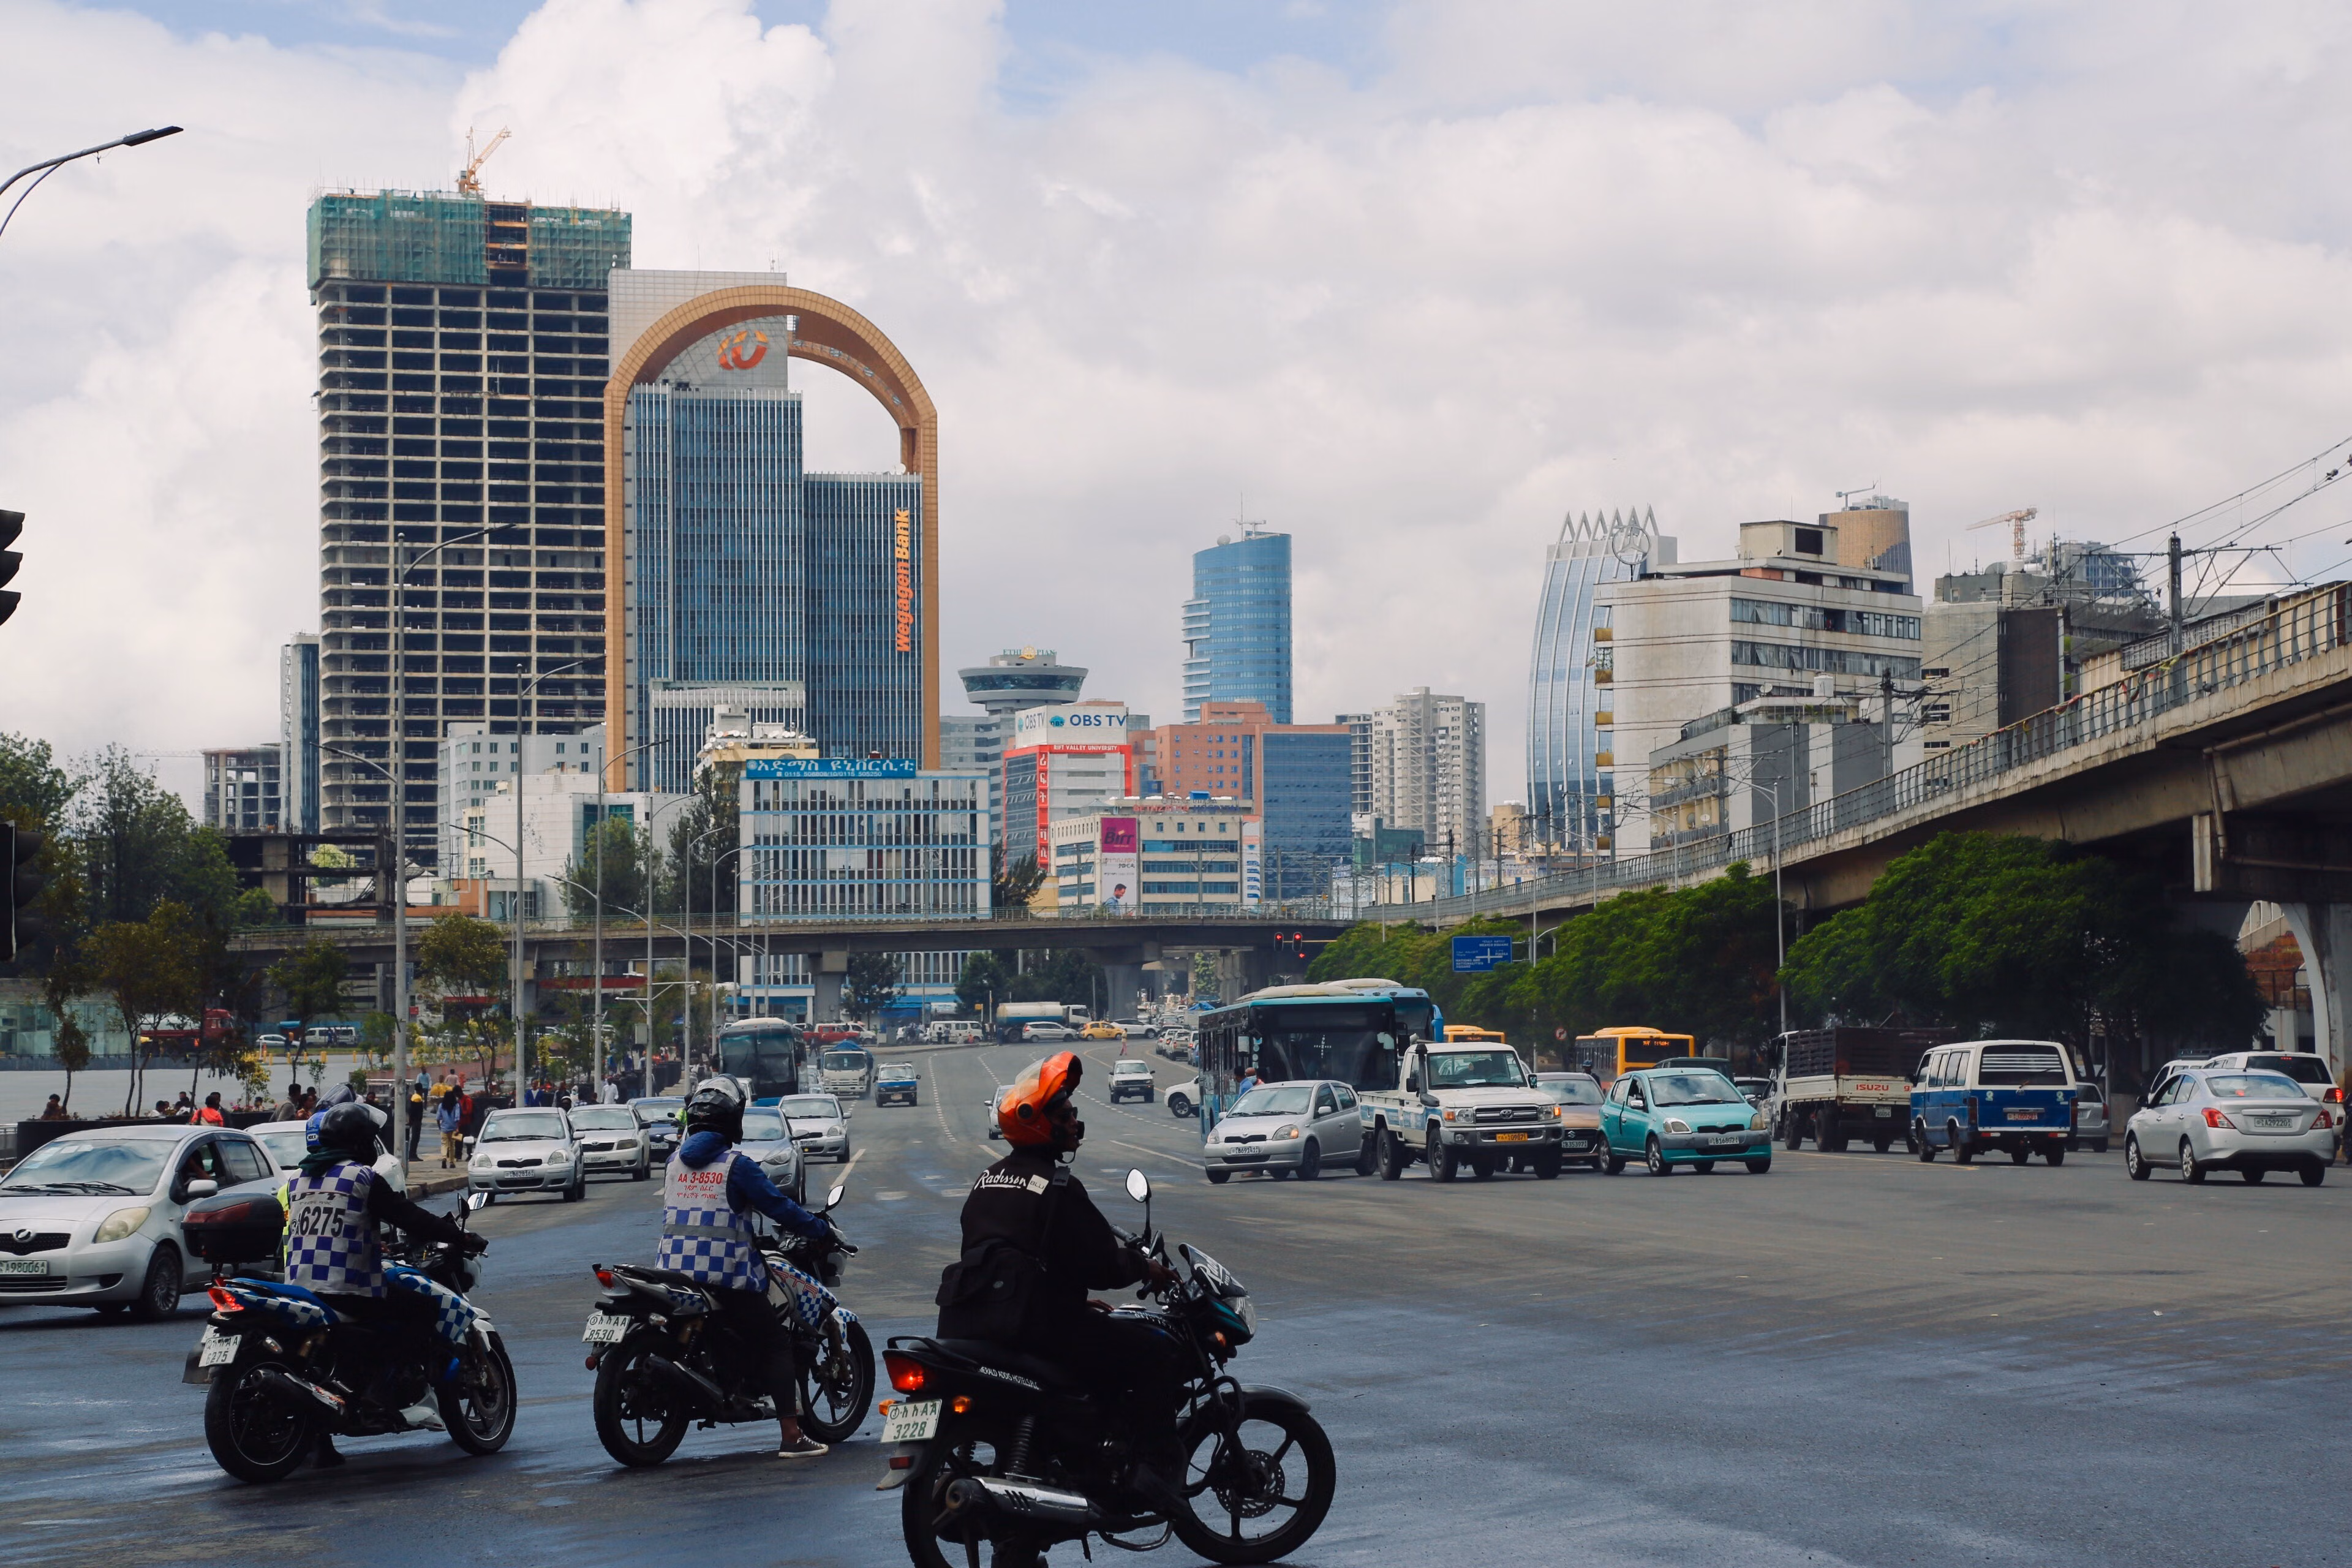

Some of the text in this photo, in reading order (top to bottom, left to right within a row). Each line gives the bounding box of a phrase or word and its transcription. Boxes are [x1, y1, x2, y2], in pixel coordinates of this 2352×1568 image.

[895, 508, 914, 651] Wegagen Bank
[1025, 712, 1045, 729] OBS TV
[1070, 714, 1127, 726] OBS TV
[757, 760, 914, 772] አድማስ ዩኒቨርሲቲ
[1104, 830, 1134, 845] Birr
[677, 1172, 723, 1184] AA 3-8530
[974, 1168, 1045, 1189] Radisson BLU
[300, 1205, 346, 1237] 6275
[588, 1329, 614, 1341] 8530
[206, 1350, 229, 1365] 6275
[998, 1371, 1012, 1381] ADDIS
[893, 1421, 927, 1440] 3228
